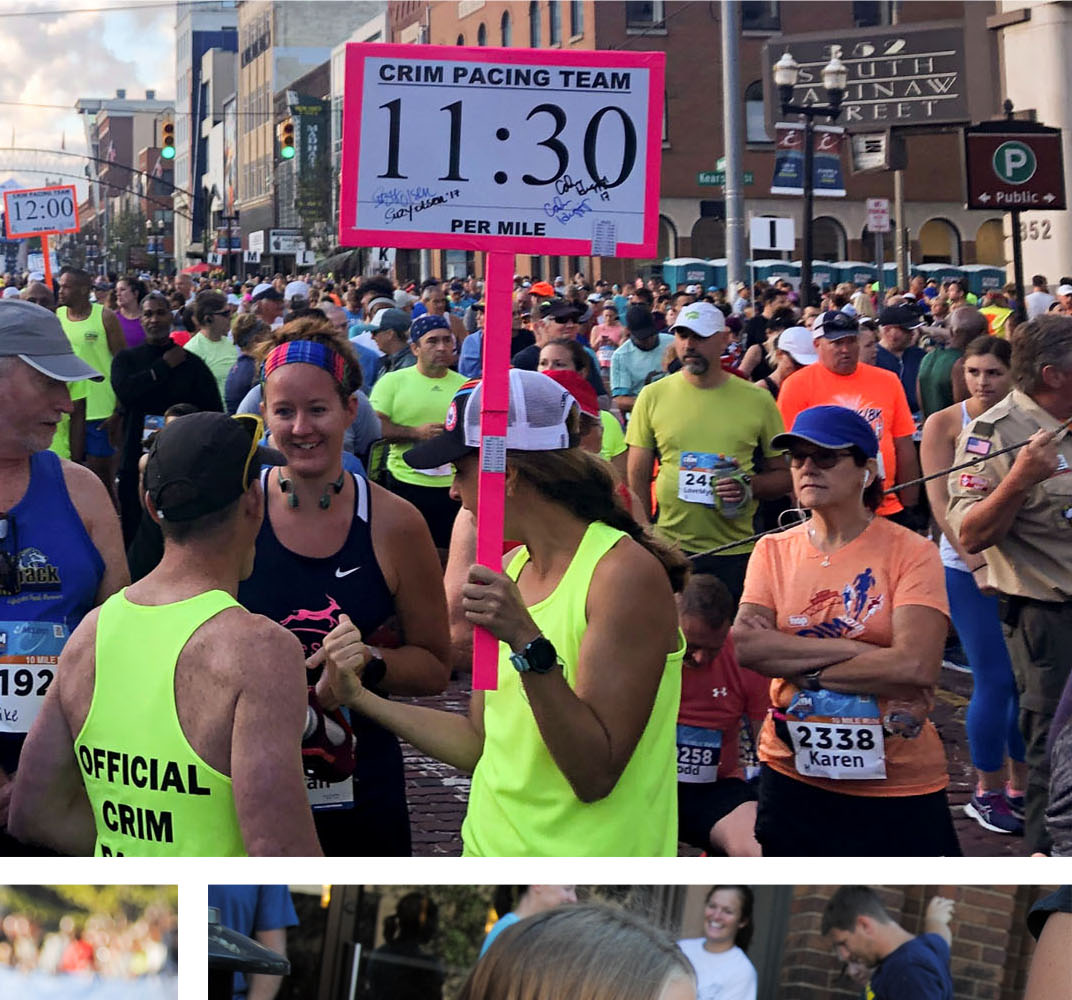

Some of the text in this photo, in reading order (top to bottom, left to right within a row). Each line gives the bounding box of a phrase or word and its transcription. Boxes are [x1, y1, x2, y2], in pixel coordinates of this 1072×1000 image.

[379, 64, 631, 90] CRIM PACING TEAM
[799, 57, 934, 82] SUTH
[789, 76, 957, 103] AINAW
[824, 100, 939, 122] REET
[377, 98, 637, 188] 11:30
[1004, 148, 1027, 178] P
[996, 191, 1039, 203] Public
[15, 197, 73, 221] 12:00
[451, 219, 546, 237] PER MILE
[211, 254, 218, 263] N
[247, 251, 257, 261] M
[302, 251, 309, 263] L
[379, 247, 389, 261] K
[26, 655, 57, 664] 10 MILE
[796, 725, 875, 751] 2338
[676, 746, 713, 765] 258
[809, 750, 865, 768] Karen
[79, 745, 211, 796] OFFICIAL
[677, 765, 700, 776] odd
[102, 800, 174, 843] CRIM
